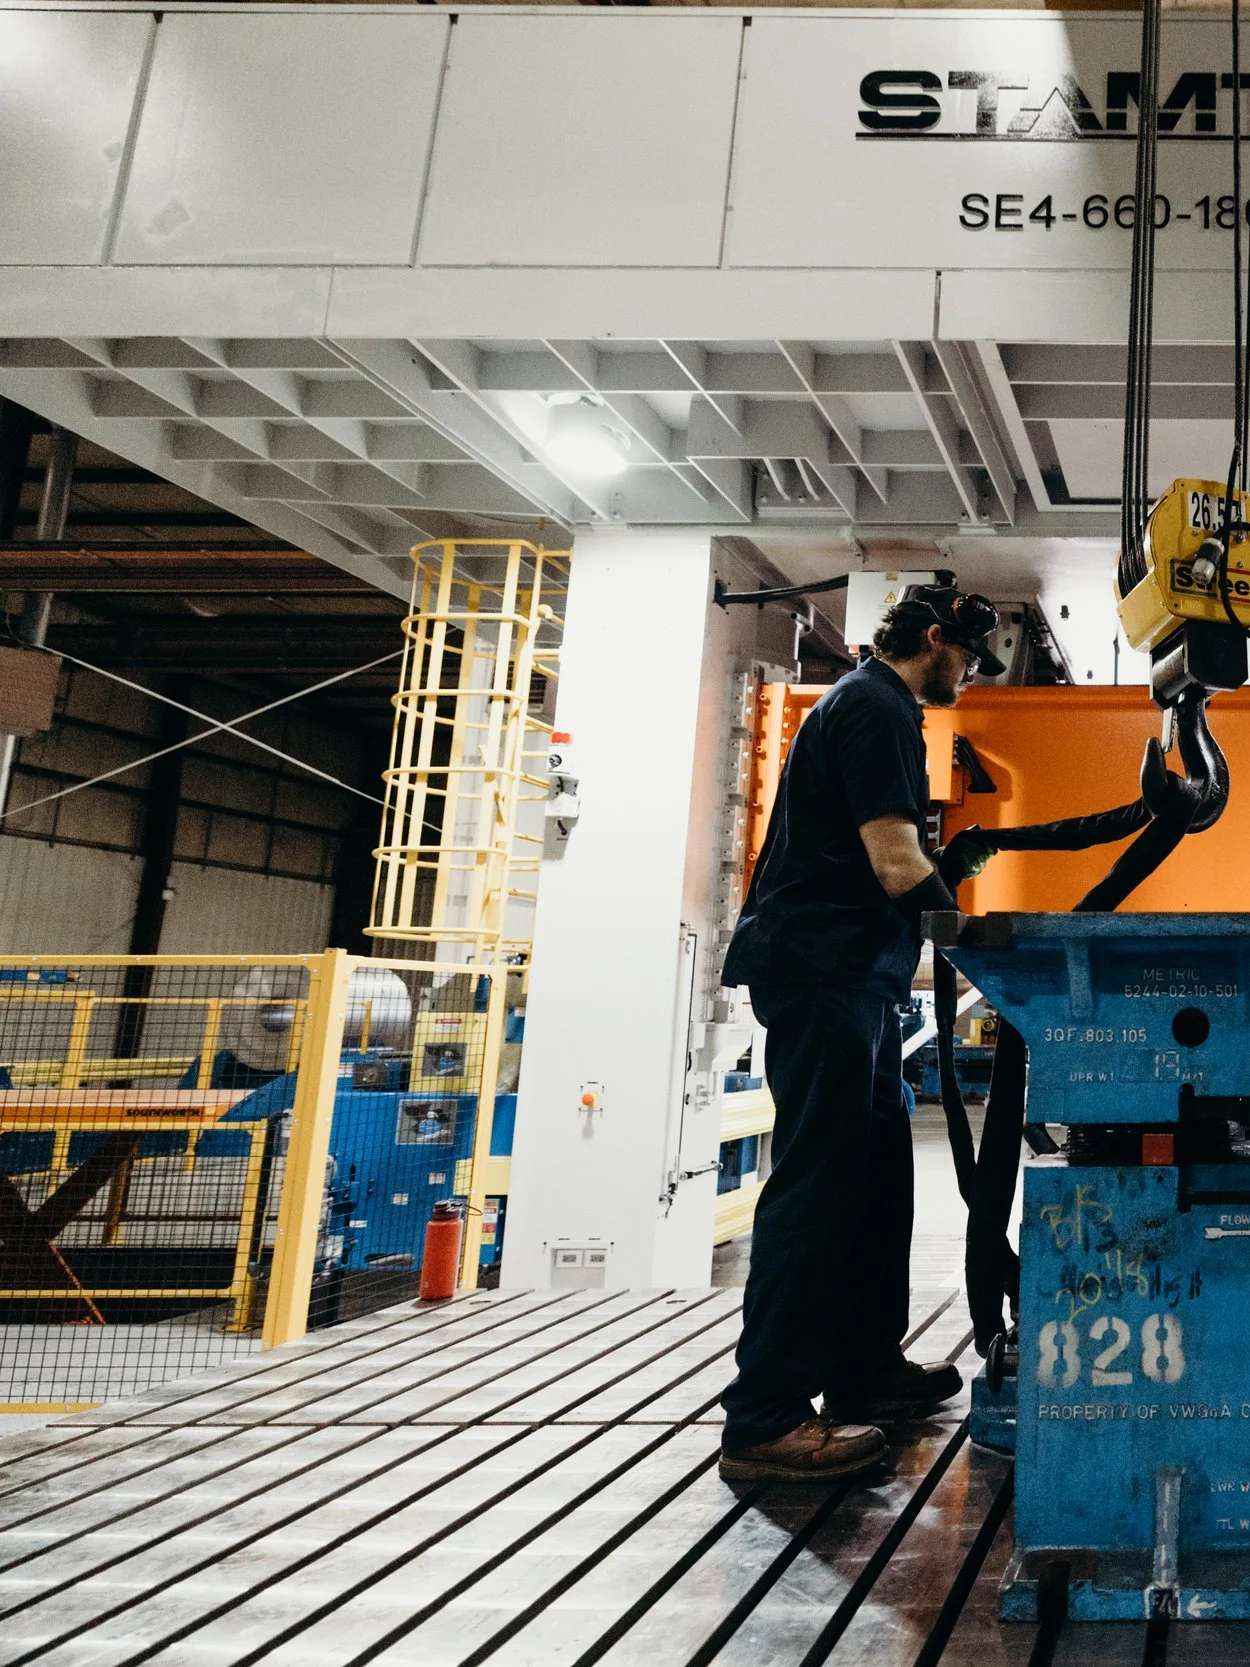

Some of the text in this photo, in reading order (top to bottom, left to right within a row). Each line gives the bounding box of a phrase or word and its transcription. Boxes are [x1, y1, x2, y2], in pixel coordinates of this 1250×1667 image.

[1143, 968, 1200, 981] METRIC
[1124, 984, 1238, 998] 5244-02-10-501
[126, 1109, 200, 1117] SOUTHWORTH
[1220, 1214, 1250, 1225] FLOW
[1037, 1313, 1186, 1388] 828
[1038, 1404, 1129, 1420] PROPERTY
[1137, 1404, 1161, 1419] OF
